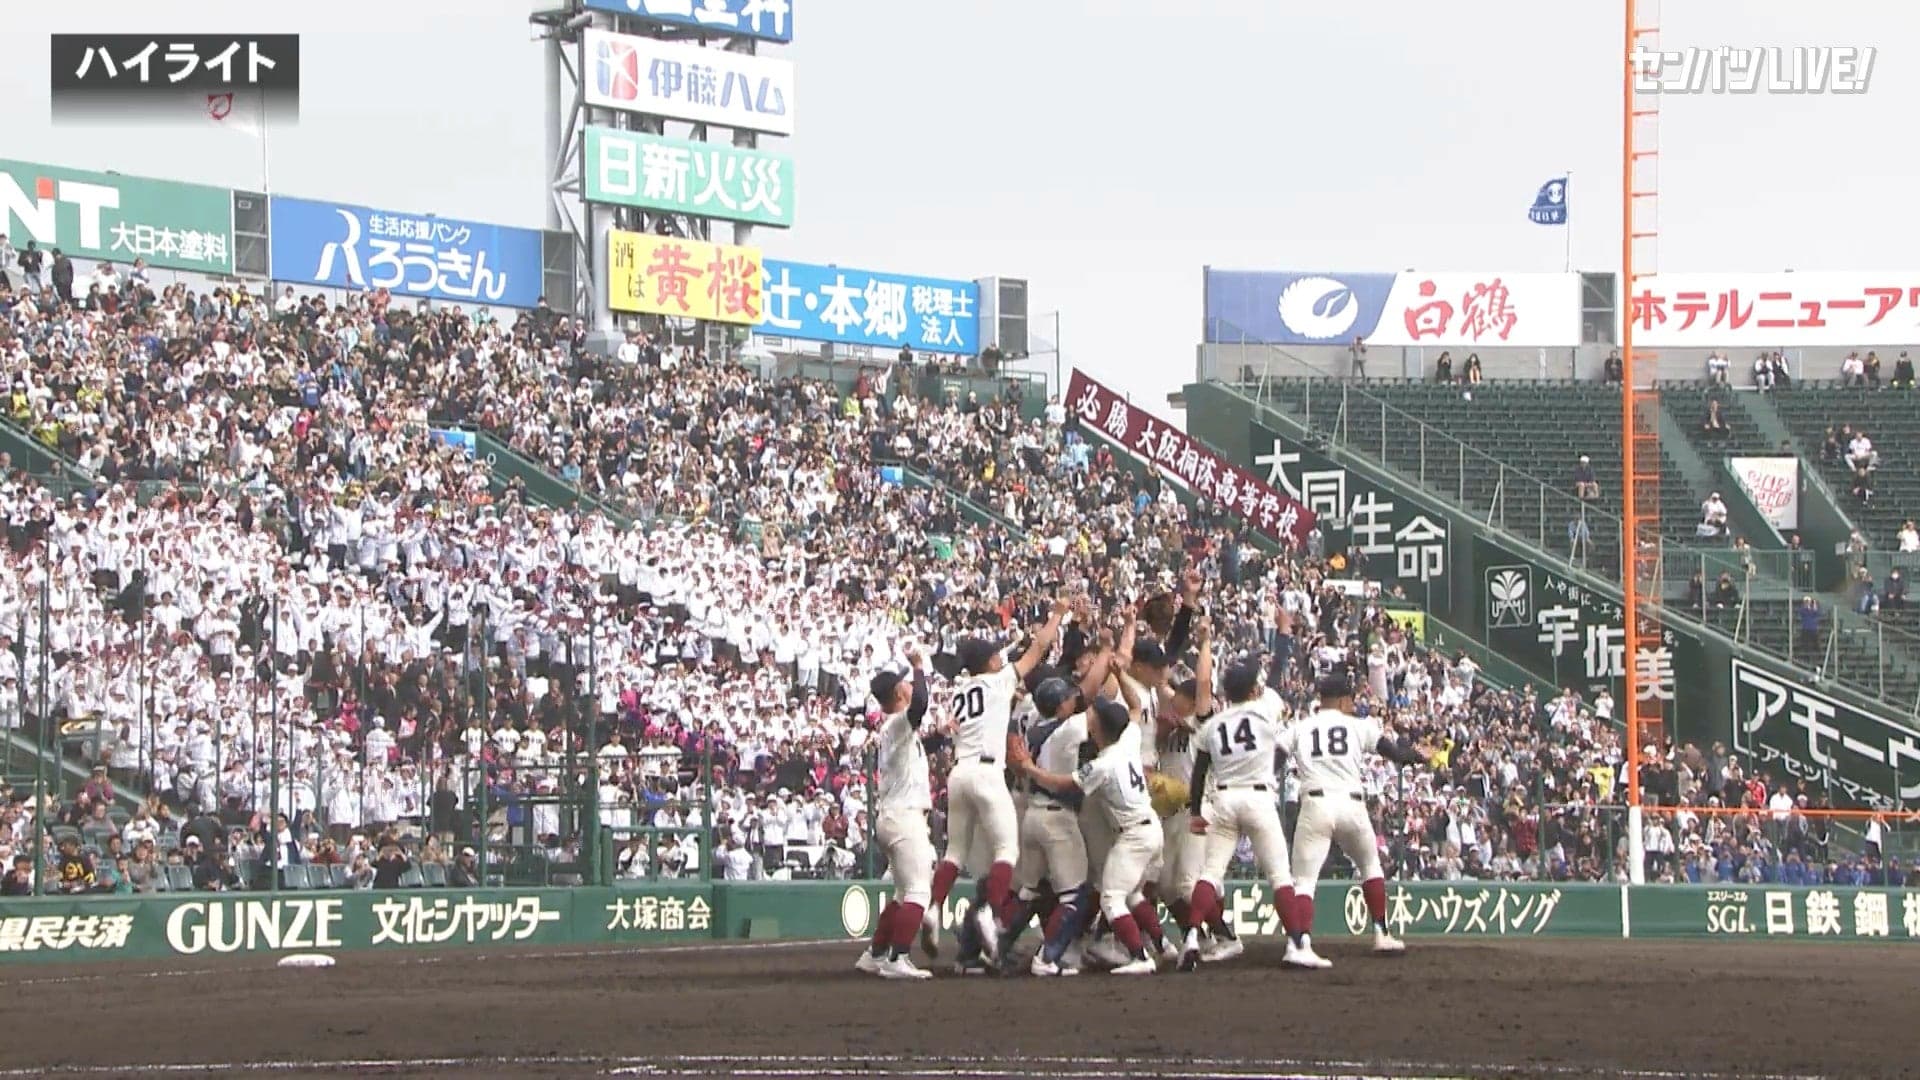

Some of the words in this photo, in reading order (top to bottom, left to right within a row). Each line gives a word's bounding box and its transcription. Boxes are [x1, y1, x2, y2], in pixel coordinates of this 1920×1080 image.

[648, 58, 786, 116] 伊藤ハム
[599, 135, 783, 218] 日新火災
[110, 221, 229, 265] 大日本塗料
[369, 215, 472, 246] 生活応援バンク
[368, 237, 507, 300] ろうきん
[647, 243, 760, 319] 黄桜
[911, 284, 974, 318] 税理士
[1404, 277, 1518, 342] 白鶴
[920, 313, 965, 347] 法人
[1254, 438, 1447, 583] 大同生命
[1537, 604, 1675, 701] 宇佐美
[952, 686, 985, 723] 20
[1217, 717, 1257, 757] 14
[1310, 725, 1348, 757] 18
[166, 899, 343, 954] GUNZE
[606, 895, 712, 930] 大塚商会
[1386, 886, 1561, 936] 本ハウズイング
